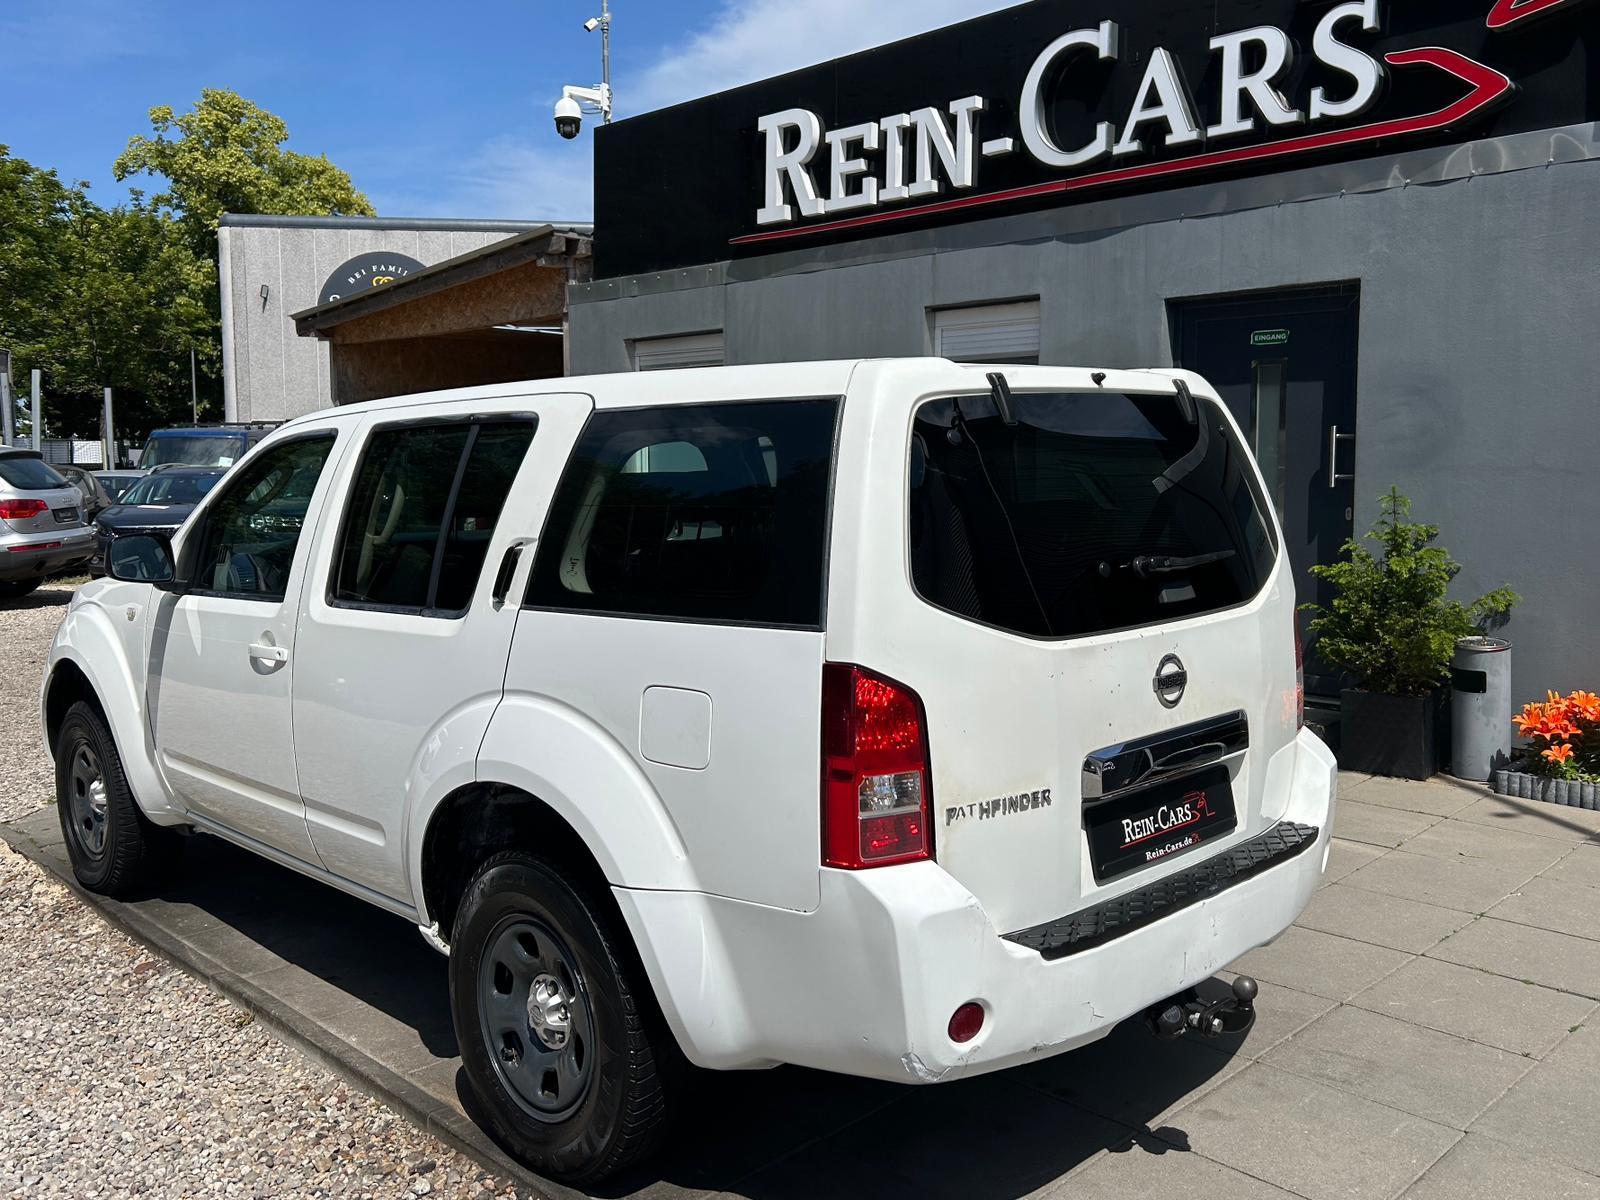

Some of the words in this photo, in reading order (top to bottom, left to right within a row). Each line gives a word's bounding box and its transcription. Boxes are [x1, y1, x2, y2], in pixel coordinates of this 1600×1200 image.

[756, 0, 1386, 226] REIN-CARS
[347, 268, 366, 284] BEI
[1254, 333, 1286, 342] EINGANG
[945, 788, 1052, 826] PATHFINDER
[1121, 803, 1192, 843] REIN-CARS
[1145, 837, 1193, 861] Rein-Cars.de
